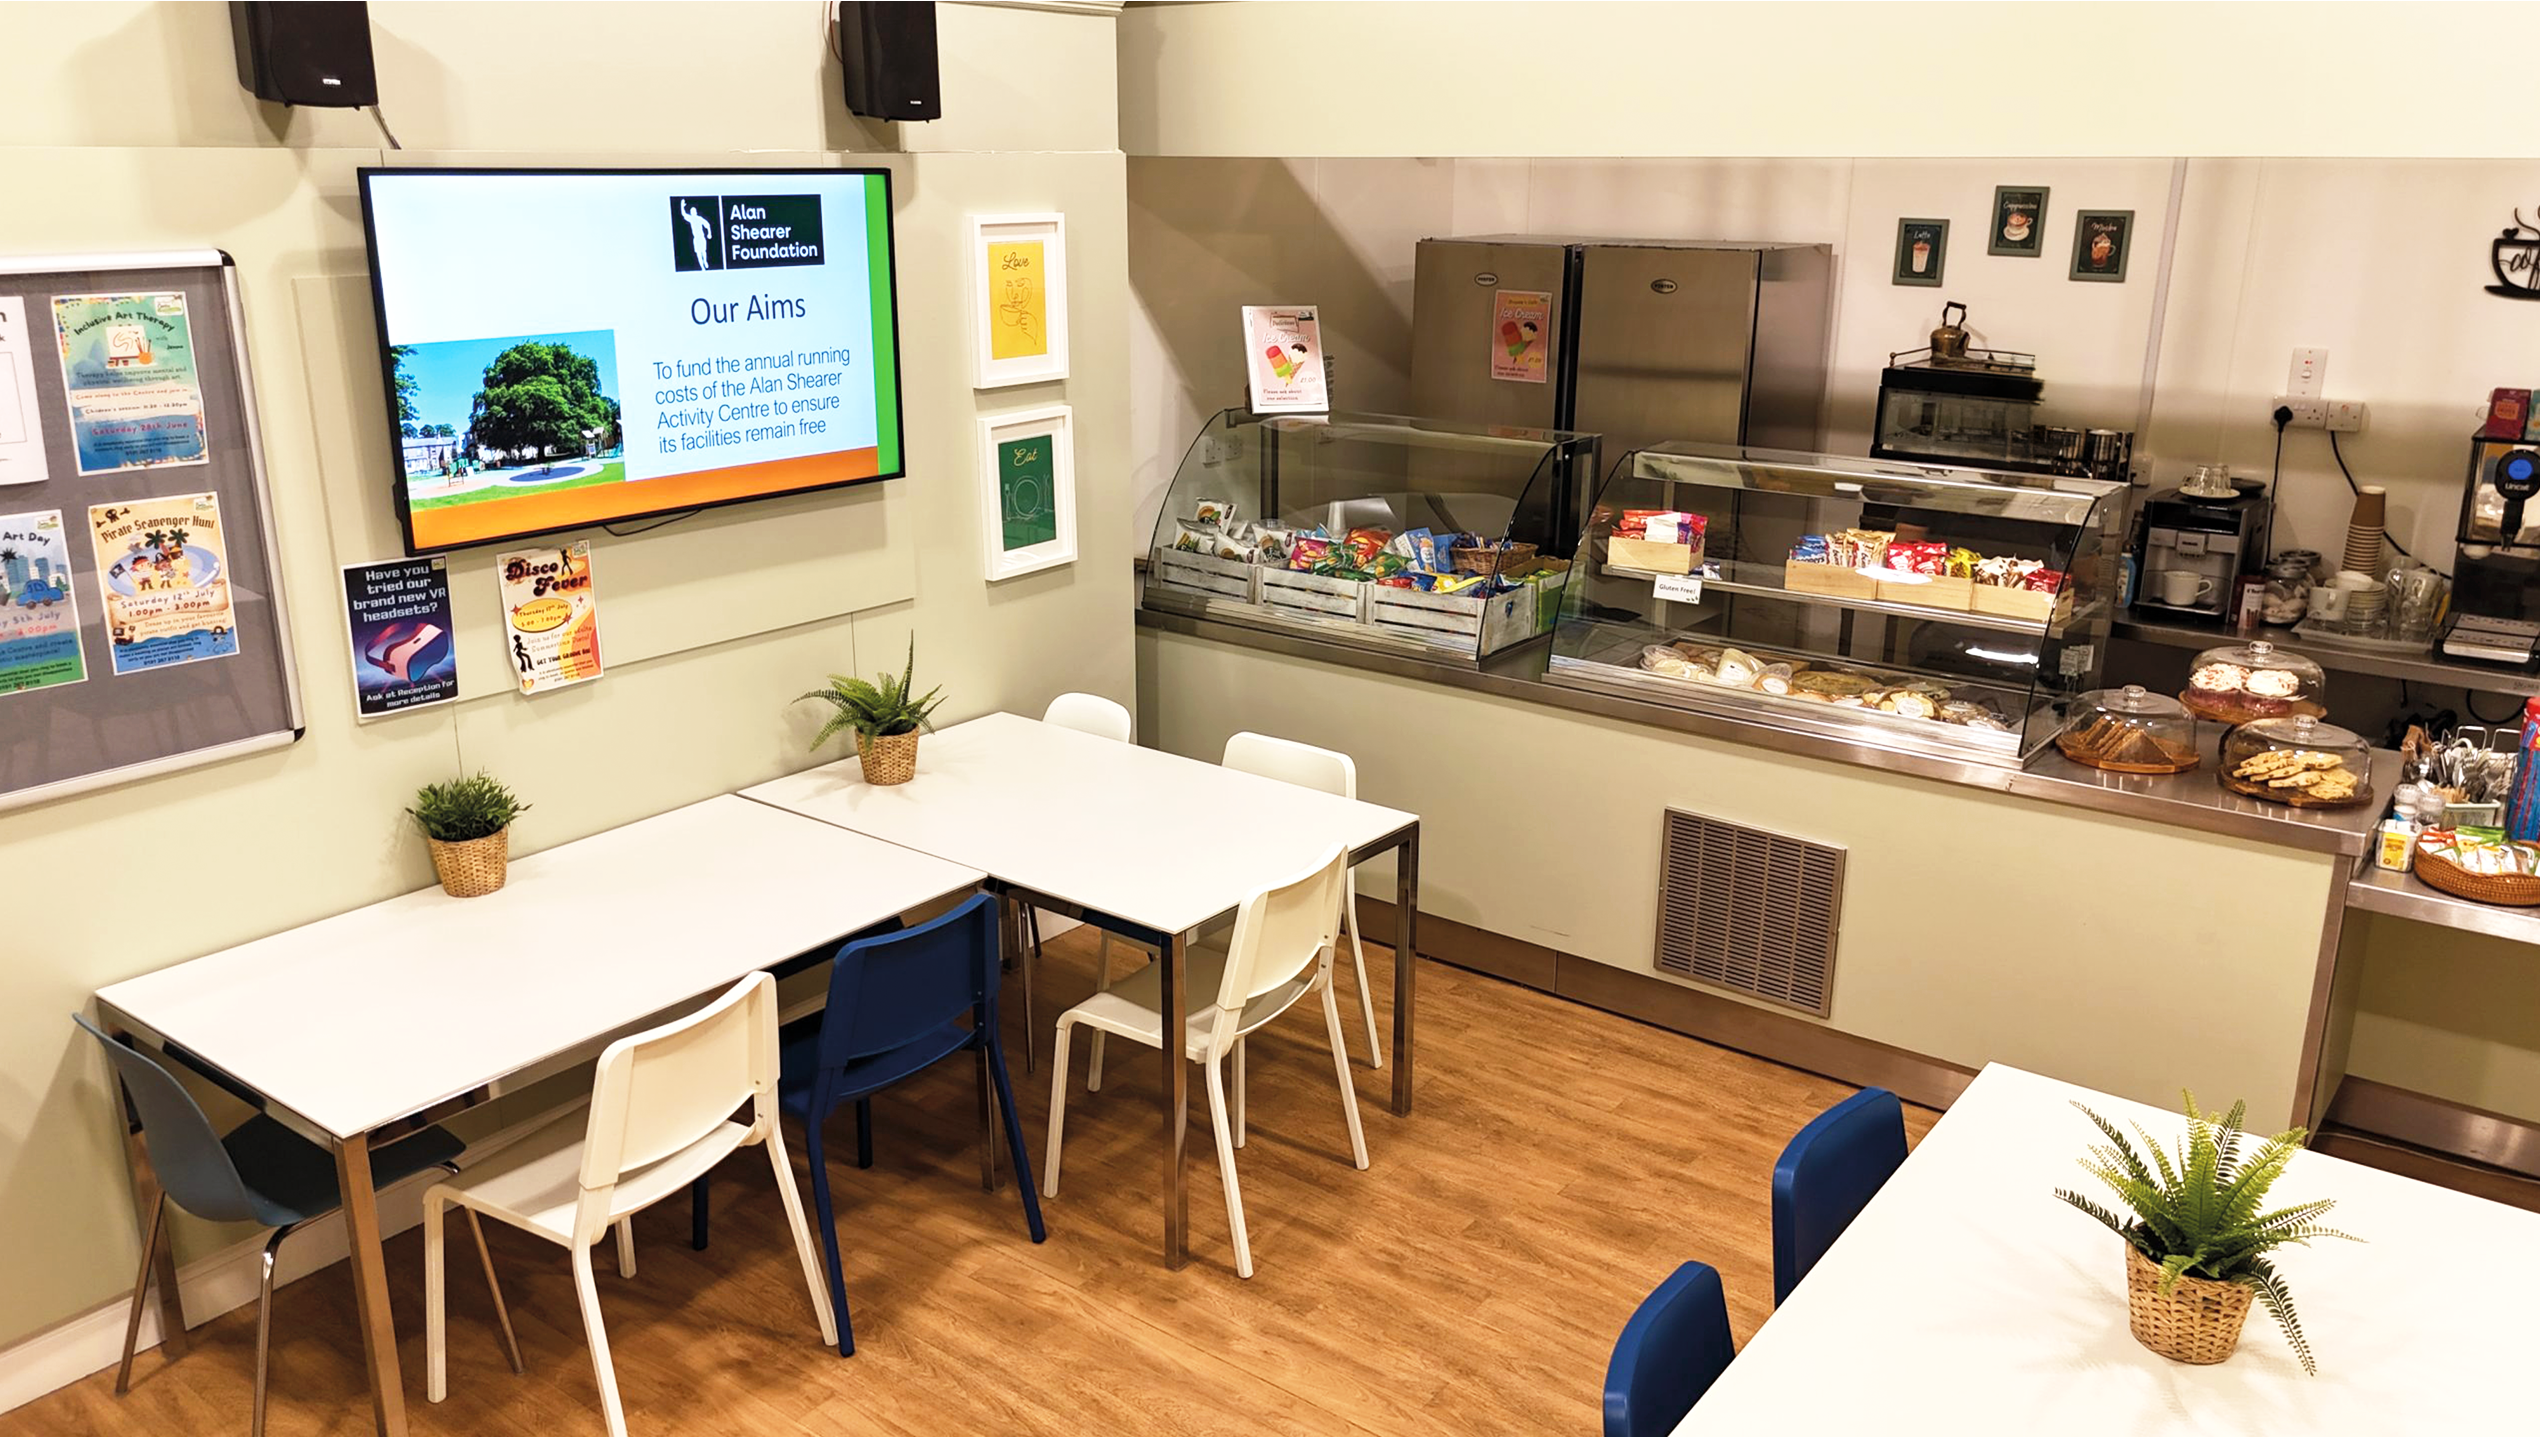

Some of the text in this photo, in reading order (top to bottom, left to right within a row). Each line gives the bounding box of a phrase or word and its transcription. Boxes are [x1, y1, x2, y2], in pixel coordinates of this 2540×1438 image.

[730, 204, 766, 220] Alan
[730, 224, 792, 240] Shearer
[732, 242, 818, 260] Foundation
[1002, 252, 1030, 270] Love
[691, 294, 806, 325] Our Aims
[1500, 308, 1544, 320] Ice Cream
[74, 312, 176, 336] Inclusive Art Therapy
[1263, 332, 1311, 344] Ice Cream
[653, 346, 850, 380] To fund the annual running
[655, 372, 843, 405] costs of the Alan Shearer
[657, 395, 840, 430] Activity Centre to ensure
[92, 426, 138, 436] Saturday
[166, 422, 188, 430] June
[659, 418, 826, 454] its facilities remain free
[1014, 448, 1038, 466] Eat
[101, 516, 215, 543] Pirate Scavenger Hunt
[2, 532, 50, 546] Art Day
[366, 566, 430, 582] Have you
[506, 558, 558, 580] Disco
[366, 578, 432, 594] tried our
[533, 576, 588, 597] Fever
[1659, 583, 1680, 592] Gluten
[120, 597, 168, 609] Saturday
[195, 589, 215, 598] July
[353, 587, 446, 610] brand new VR
[38, 610, 60, 621] July
[129, 608, 163, 618] 1.00pm
[363, 602, 438, 622] headsets?
[519, 608, 545, 617] Thursday
[536, 658, 547, 666] GET
[366, 680, 455, 702] Ask at Reception for
[386, 692, 440, 708] more details
